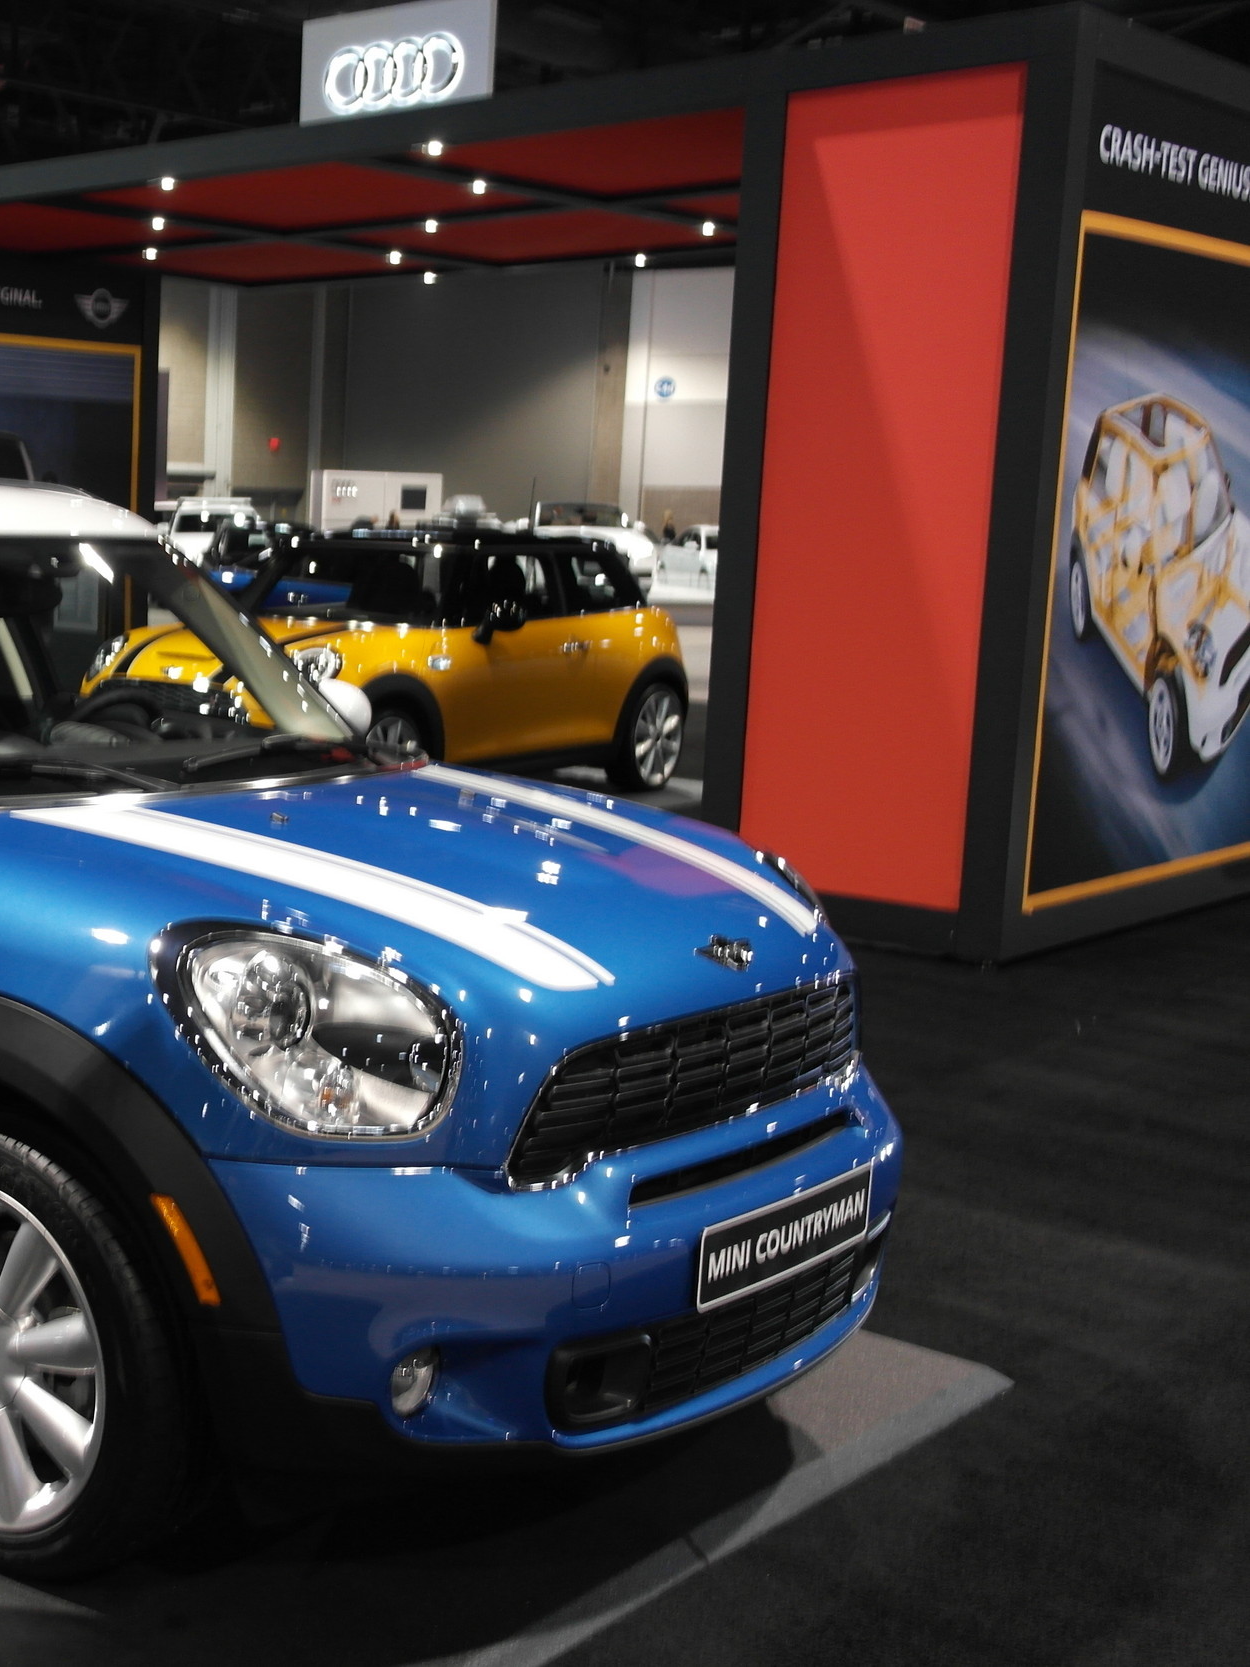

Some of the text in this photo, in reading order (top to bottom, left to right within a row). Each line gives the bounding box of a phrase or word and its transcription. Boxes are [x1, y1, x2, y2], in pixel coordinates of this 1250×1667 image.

[1099, 123, 1198, 186] CRASH-TEST
[707, 1187, 866, 1284] MINI COUNTRYMAN
